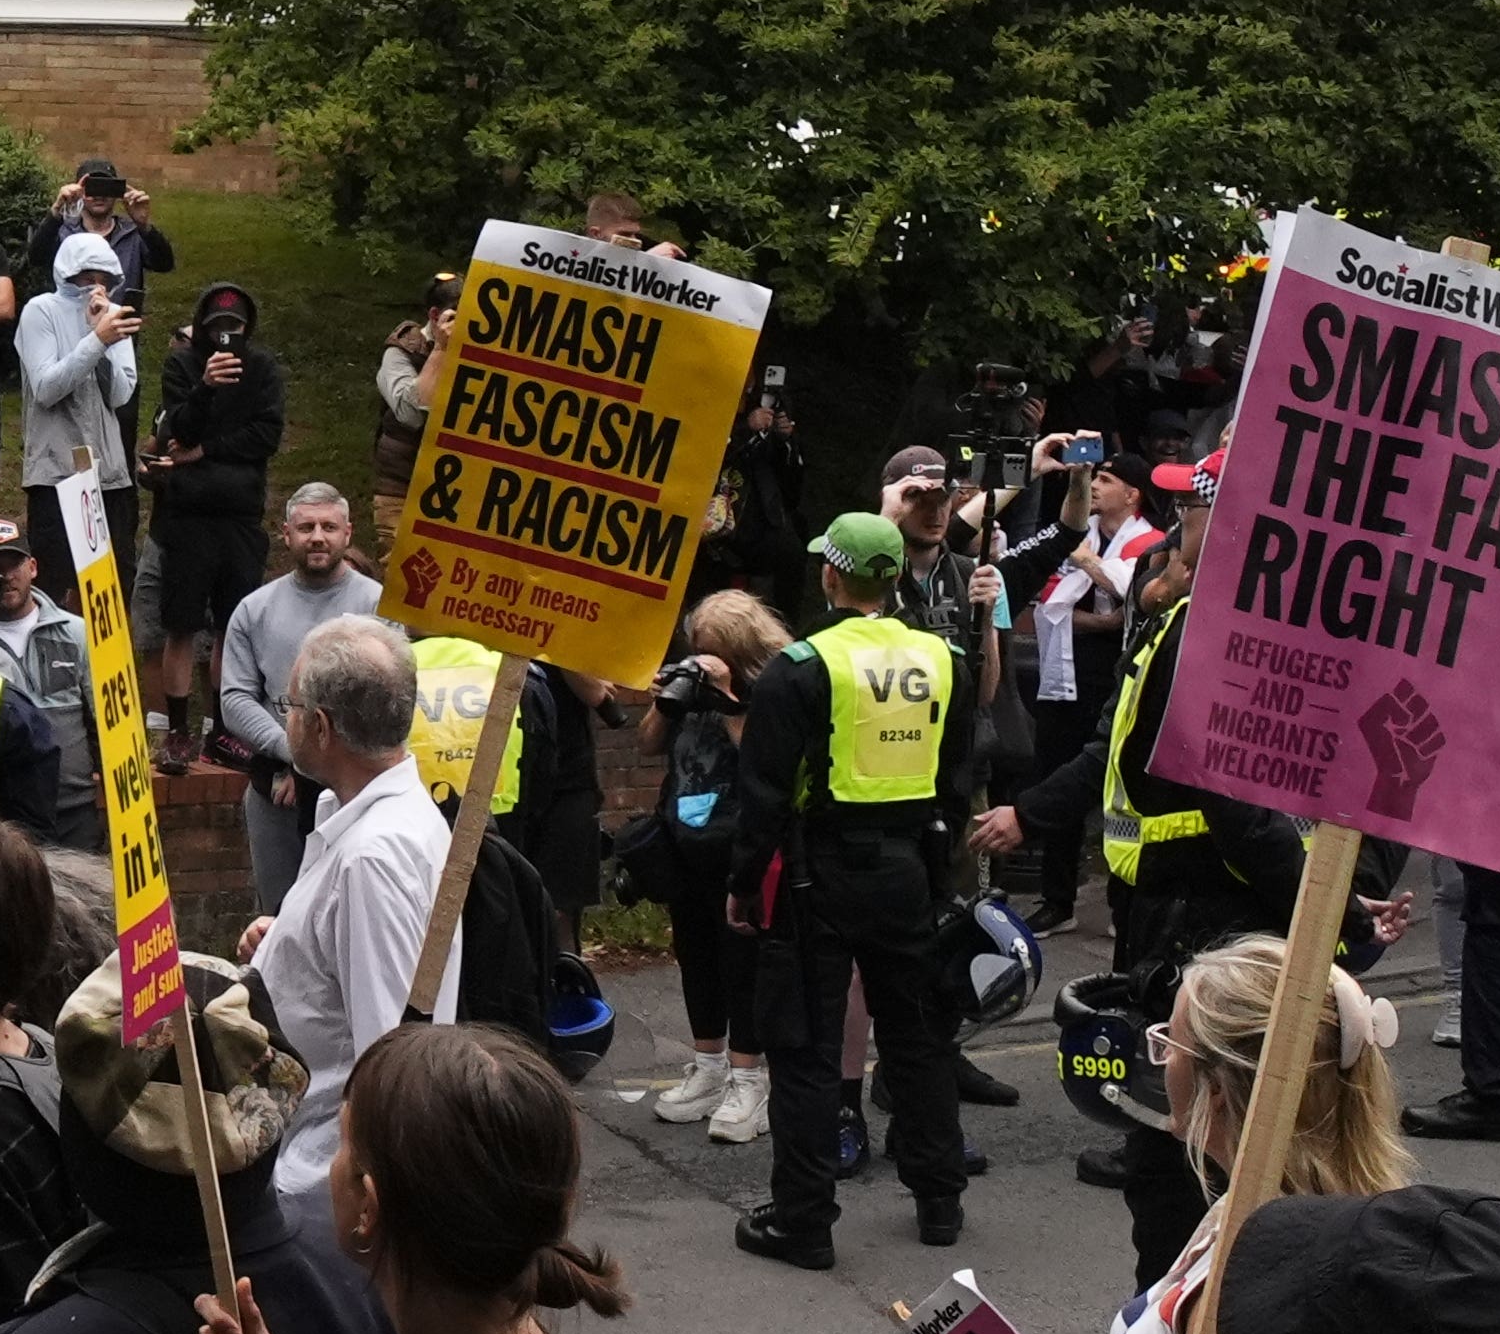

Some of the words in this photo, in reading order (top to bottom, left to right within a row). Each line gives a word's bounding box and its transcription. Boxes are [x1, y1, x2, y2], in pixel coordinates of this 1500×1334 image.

[520, 241, 629, 289] Socialist
[630, 266, 721, 312] Worker
[1336, 248, 1478, 318] Socialist
[468, 277, 662, 384] SMASH
[442, 364, 681, 484] FASCISM
[1267, 404, 1422, 536] THE
[419, 453, 460, 523] &
[476, 467, 688, 581] RACISM
[86, 579, 114, 647] Far
[442, 592, 555, 647] necessary
[450, 557, 476, 594] By
[485, 569, 524, 604] any
[530, 582, 600, 622] means
[1234, 513, 1485, 668] RIGHT
[864, 668, 930, 703] VG
[1225, 630, 1352, 691] REFUGEES
[102, 670, 130, 731] are
[1250, 678, 1304, 716] AND
[435, 747, 475, 763] 7842
[880, 729, 921, 742] 82348
[1207, 701, 1340, 762] MIGRANTS
[1204, 738, 1327, 798] WELCOME
[122, 833, 146, 899] in
[132, 923, 174, 975] Justice
[132, 972, 156, 1018] and
